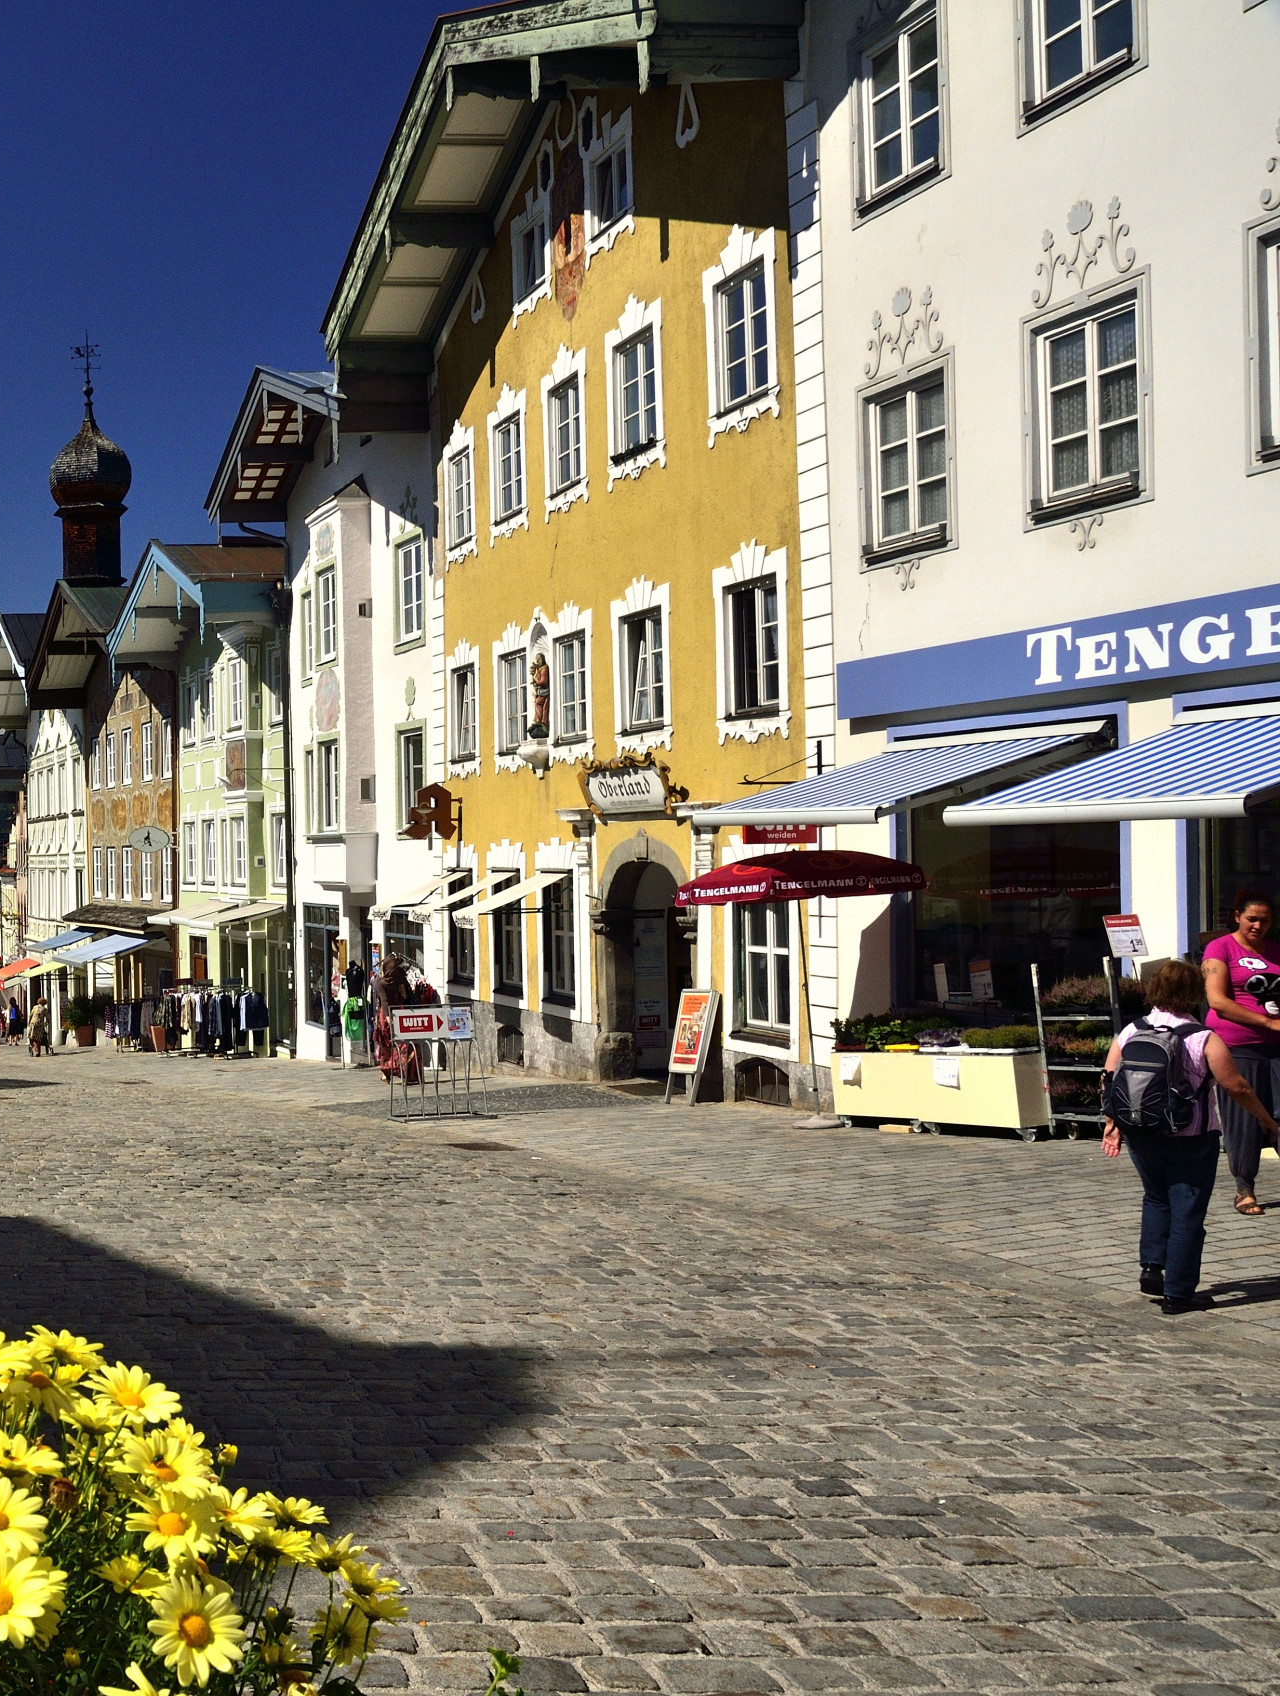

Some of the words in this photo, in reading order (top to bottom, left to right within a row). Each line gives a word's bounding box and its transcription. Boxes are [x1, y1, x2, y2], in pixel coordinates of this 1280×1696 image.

[597, 775, 651, 798] Oberland
[767, 831, 797, 839] weiden
[774, 878, 854, 890] TENGELMANN
[693, 884, 759, 898] TENGELMANN
[403, 1016, 429, 1027] WITT
